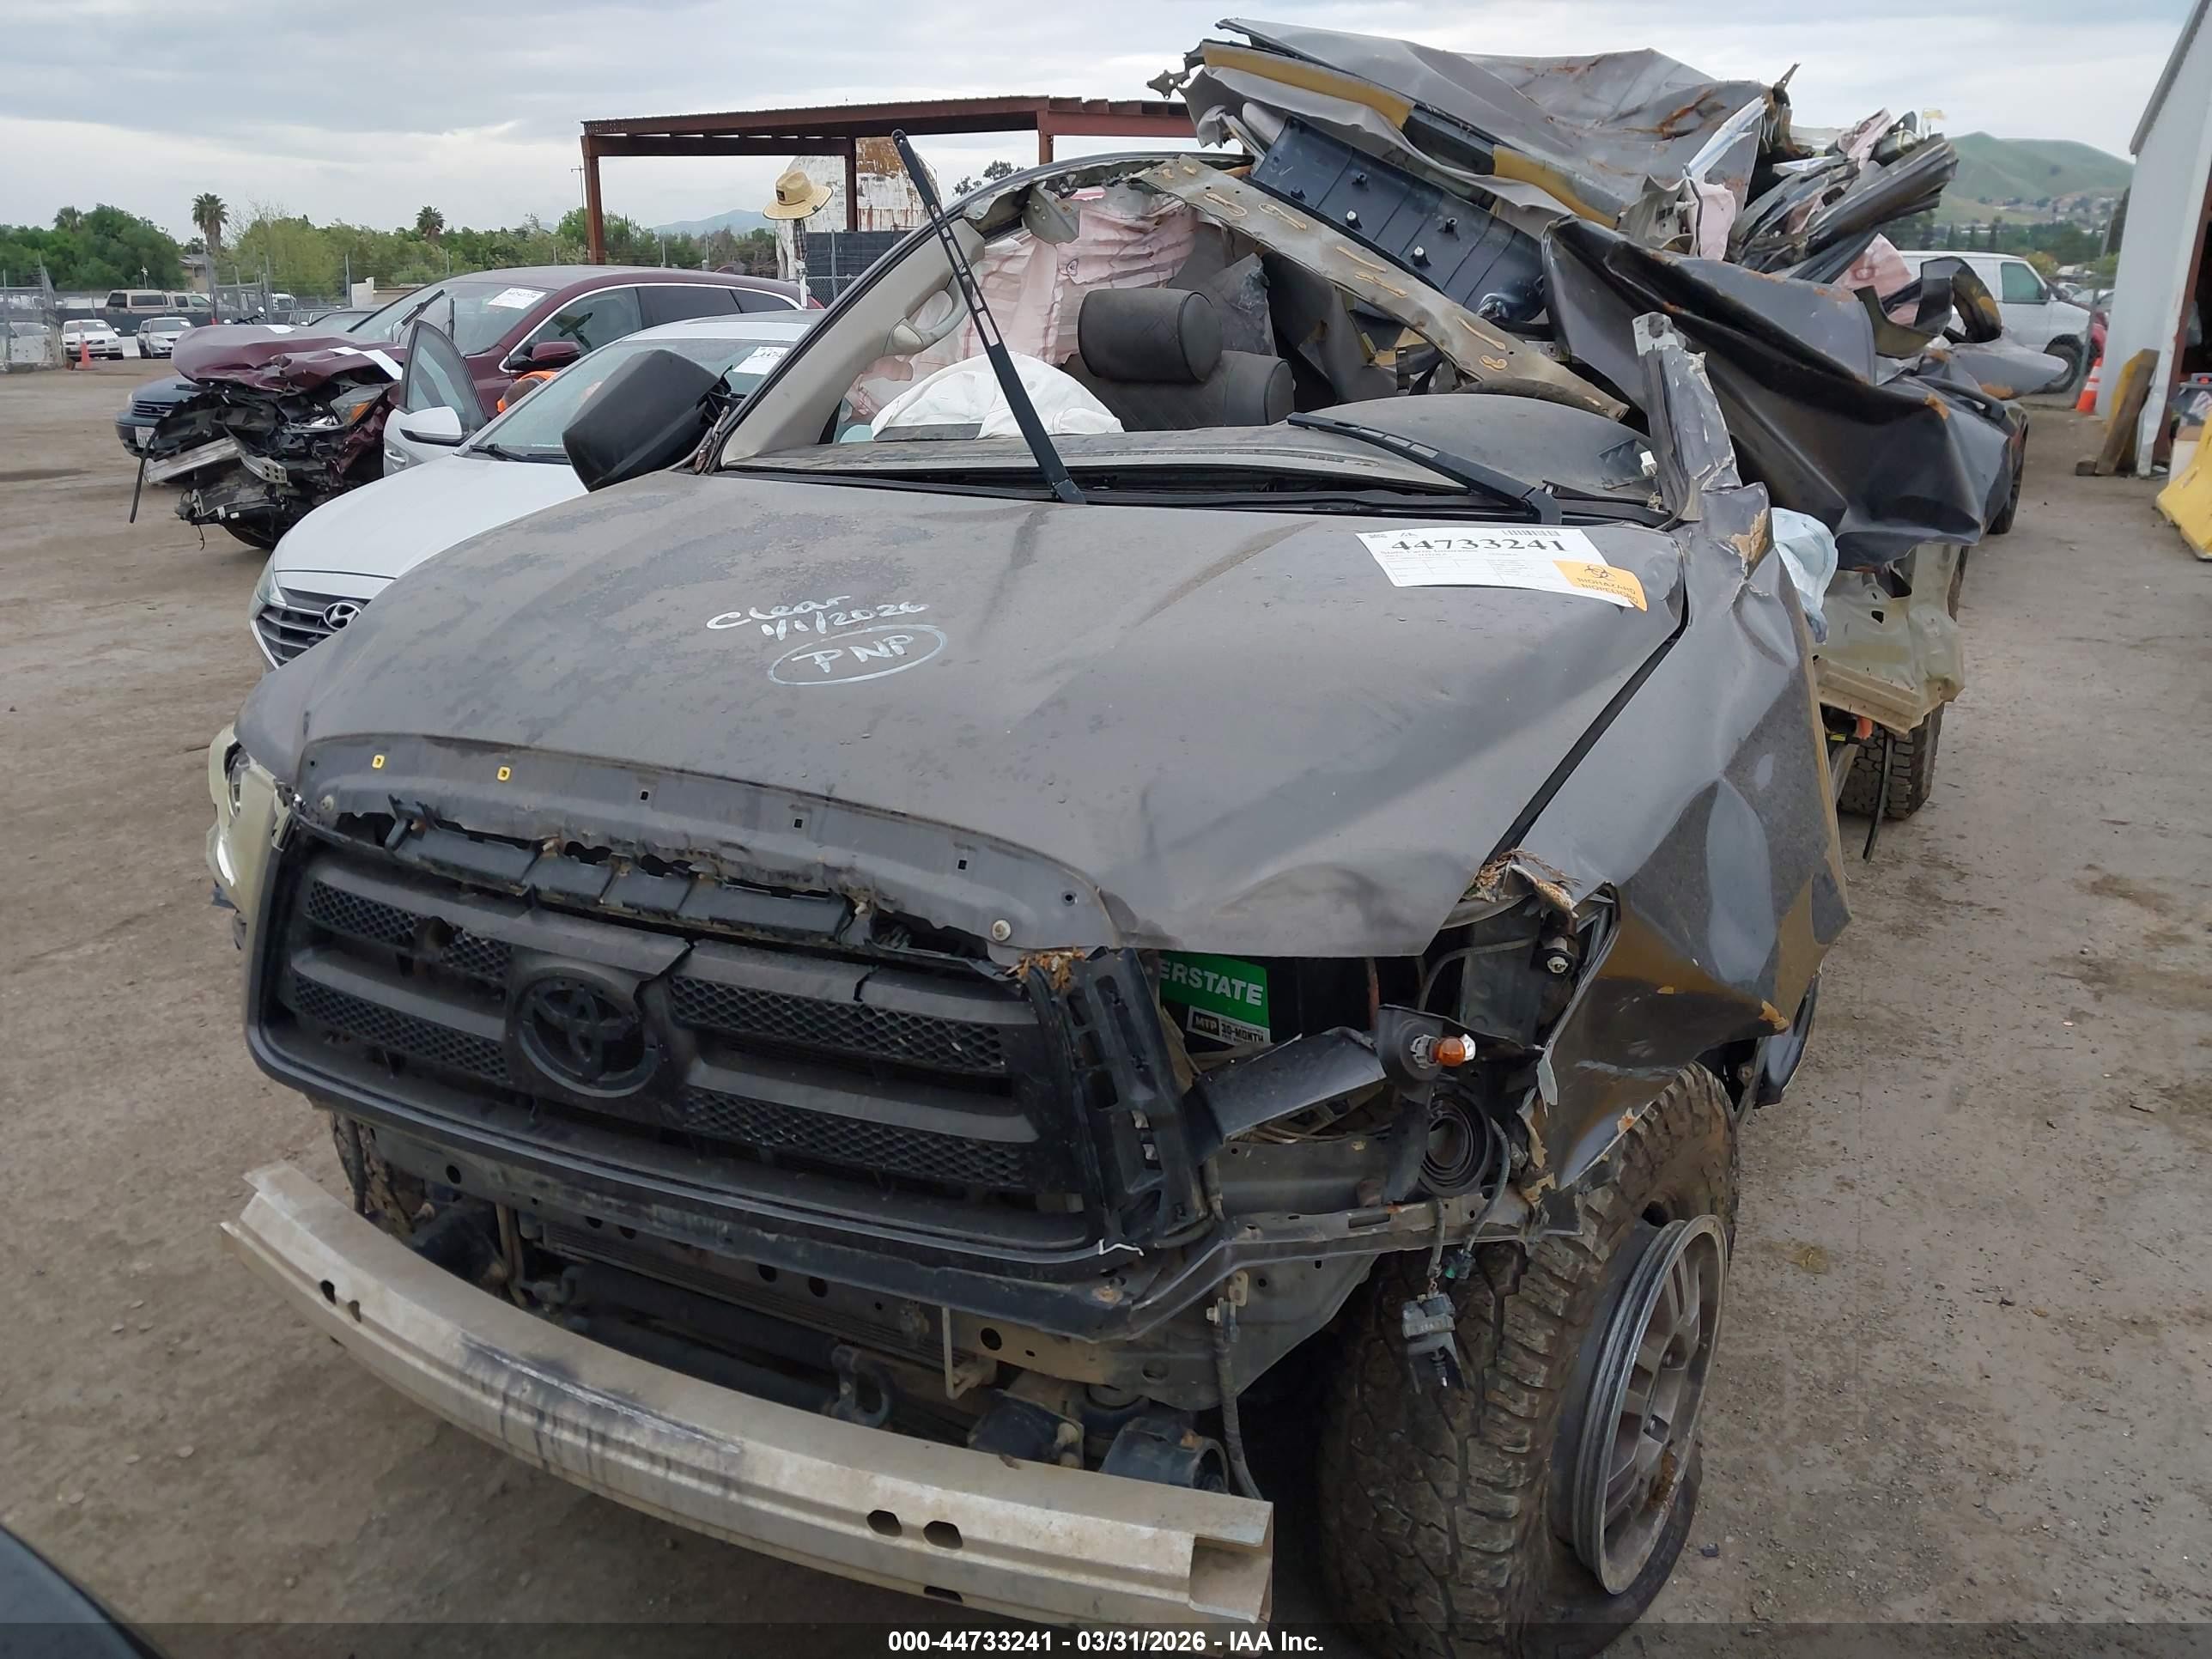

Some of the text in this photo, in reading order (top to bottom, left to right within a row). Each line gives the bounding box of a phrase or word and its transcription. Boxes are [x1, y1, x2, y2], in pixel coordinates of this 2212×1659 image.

[1391, 538, 1570, 551] 44733241
[706, 595, 851, 629] Clear
[790, 635, 914, 673] PNP
